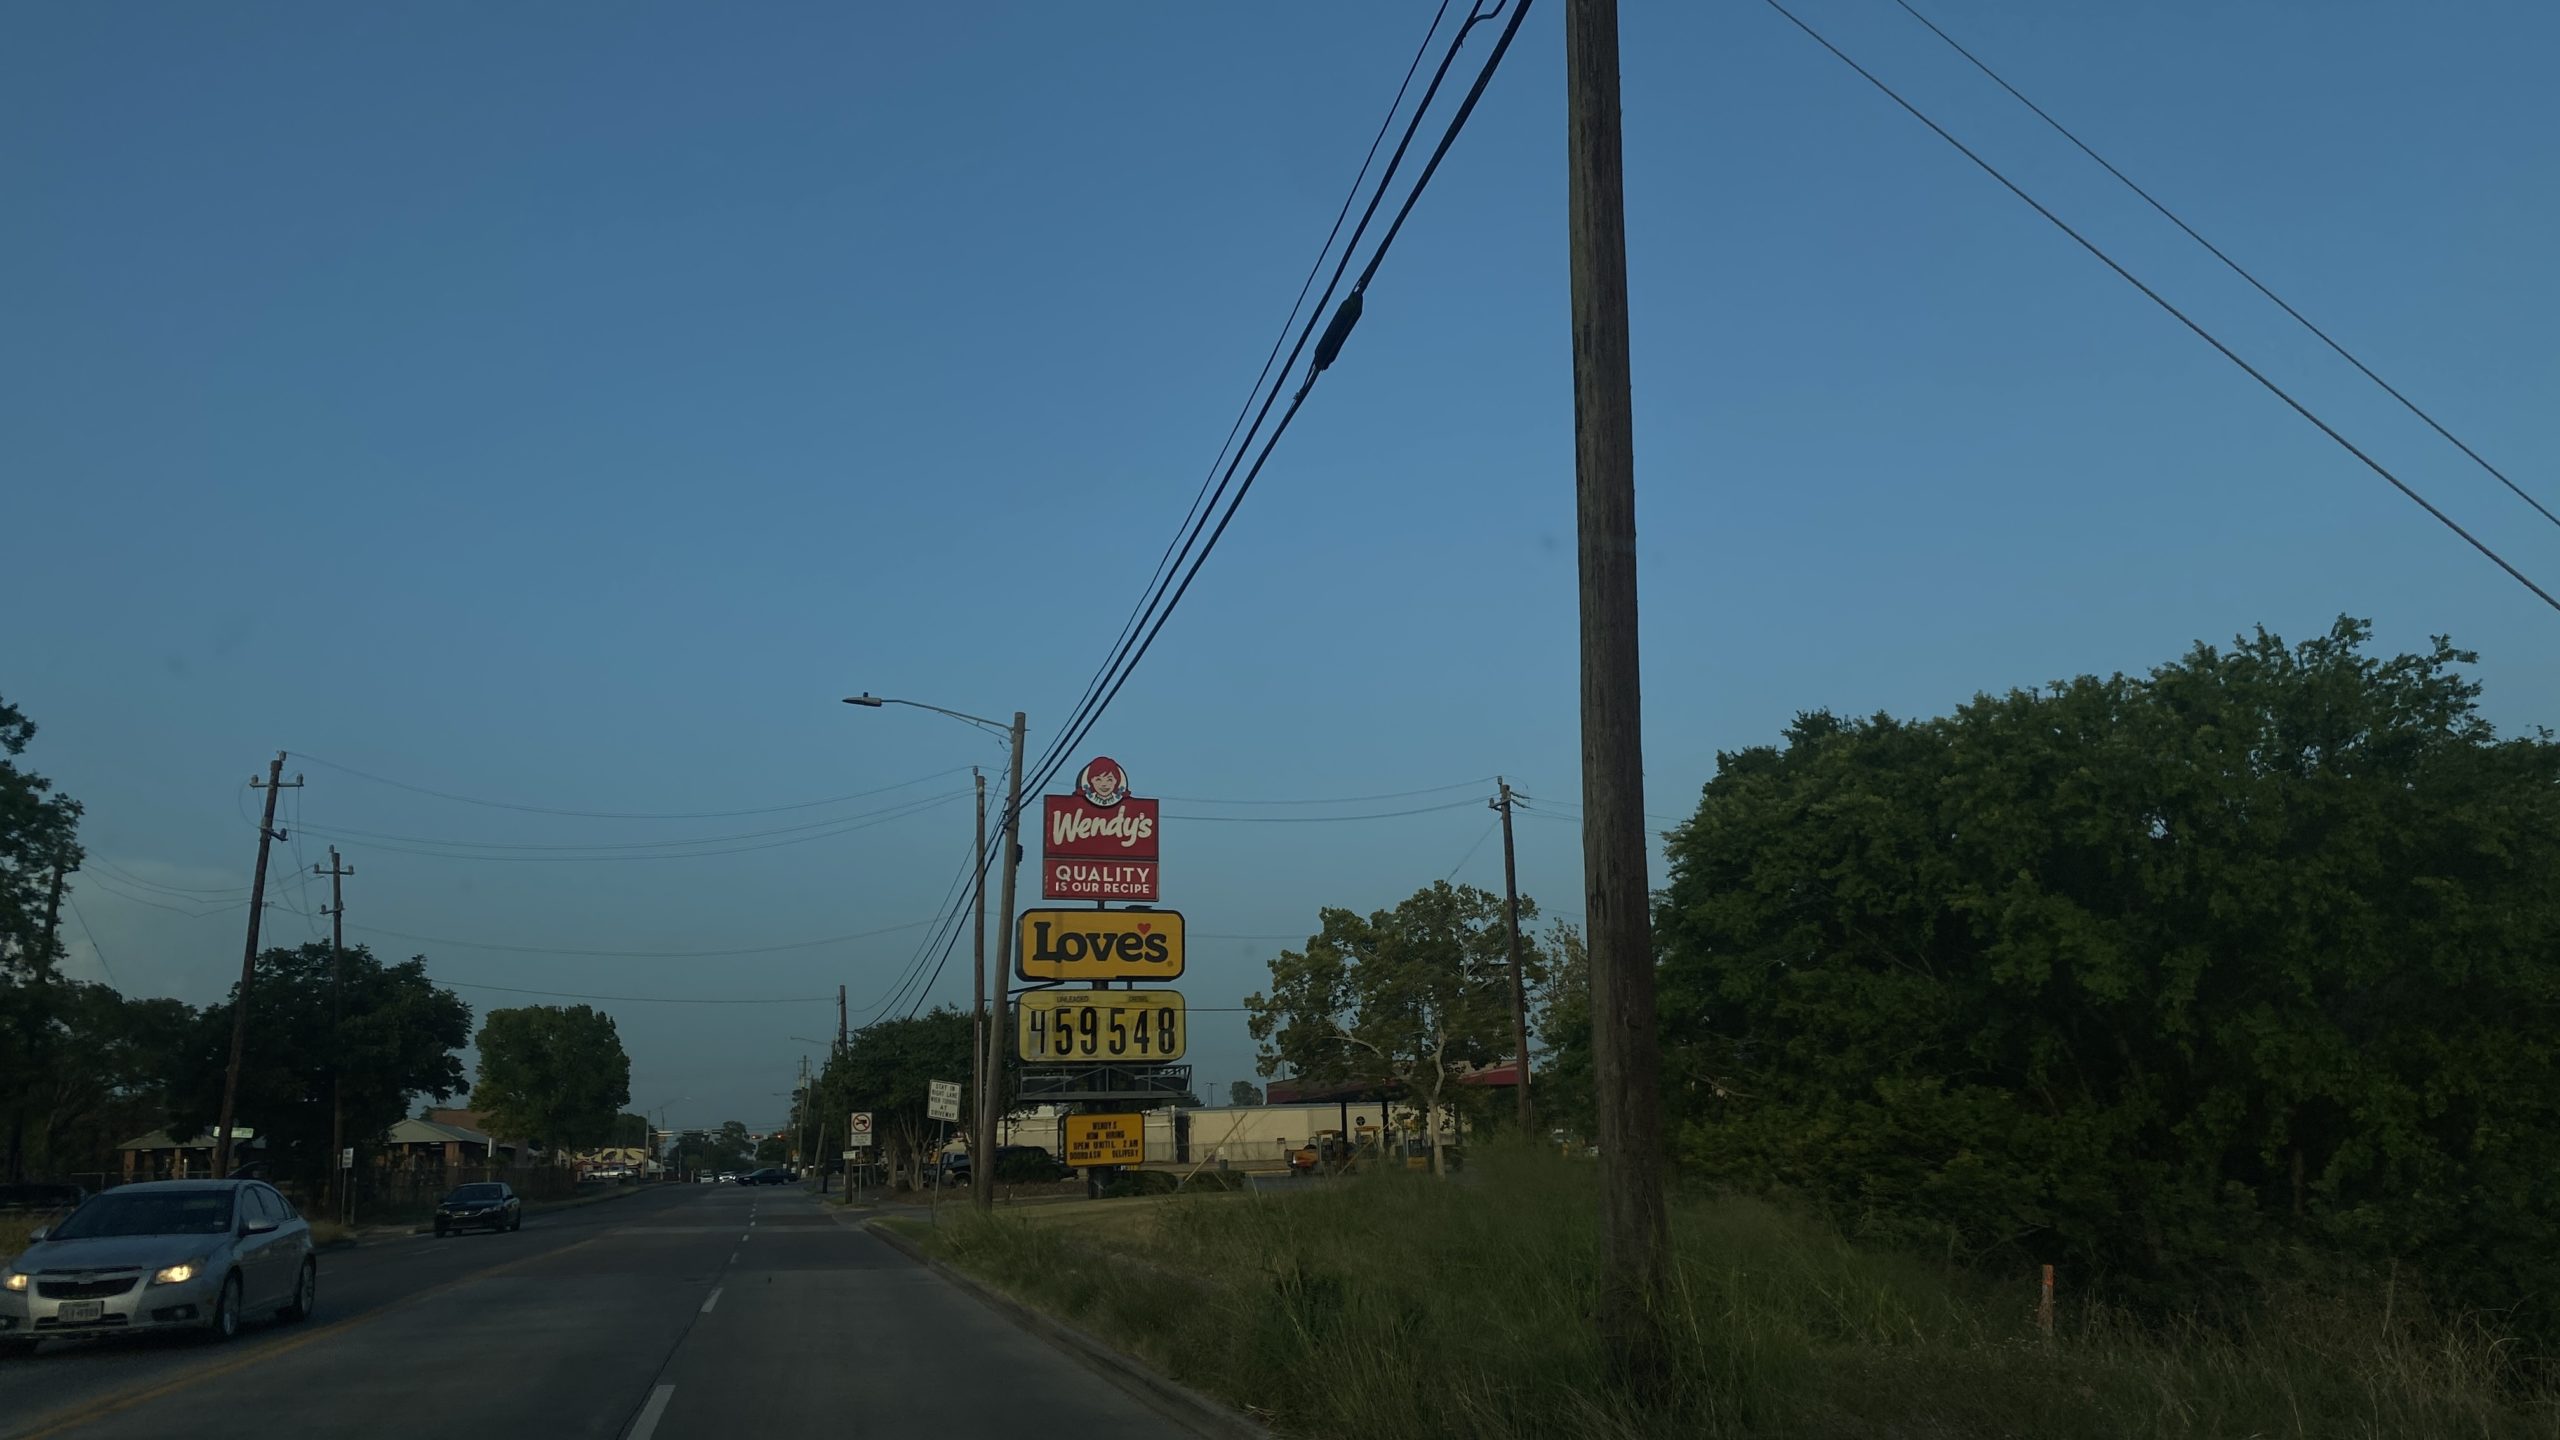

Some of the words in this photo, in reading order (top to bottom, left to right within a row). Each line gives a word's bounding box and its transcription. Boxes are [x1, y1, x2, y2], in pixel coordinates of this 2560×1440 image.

[1052, 805, 1153, 847] Wendy's
[1055, 865, 1150, 882] QUALITY
[1055, 881, 1067, 892] IS
[1071, 882, 1099, 893] OUR
[1104, 883, 1150, 894] RECIPE
